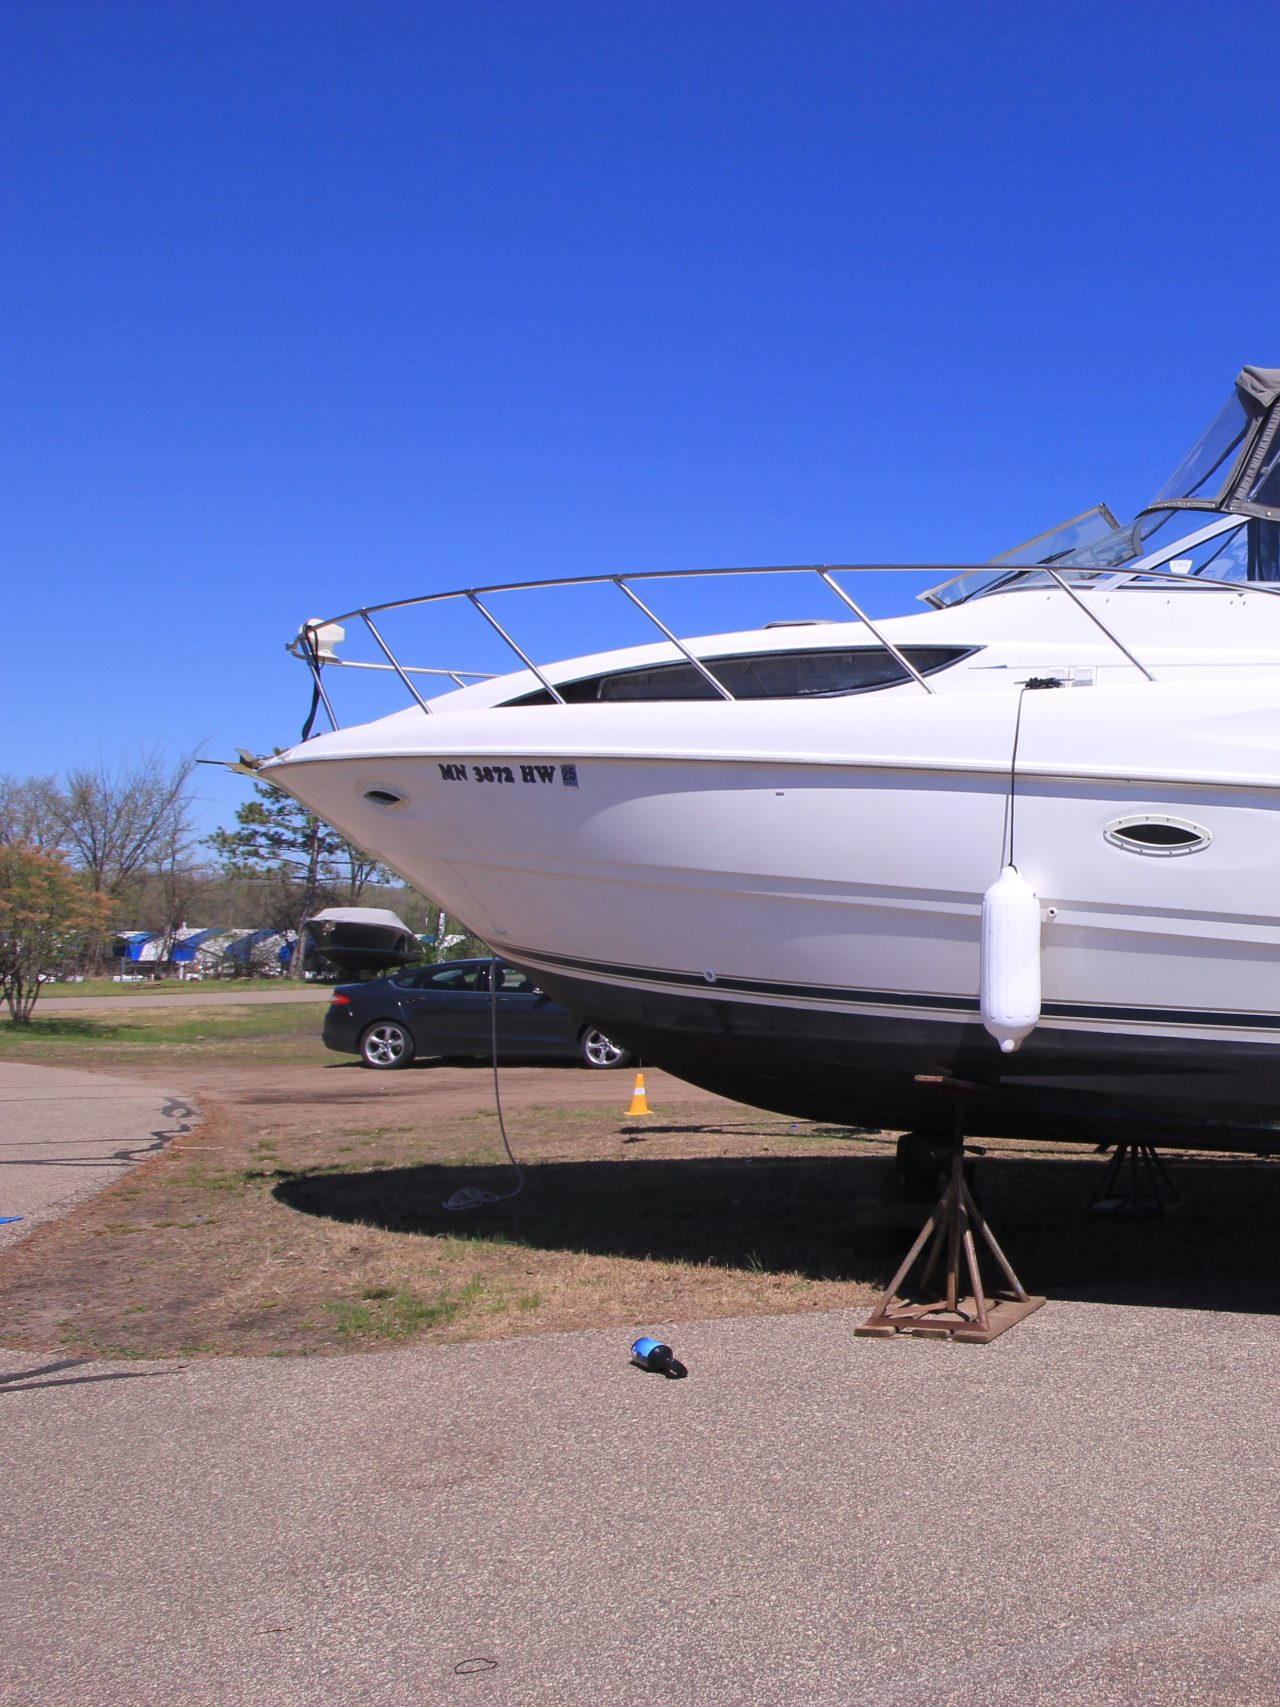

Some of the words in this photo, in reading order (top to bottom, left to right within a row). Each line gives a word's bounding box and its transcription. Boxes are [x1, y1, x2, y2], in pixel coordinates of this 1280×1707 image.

[438, 764, 468, 781] MN
[520, 765, 556, 783] HW
[562, 769, 576, 780] 25
